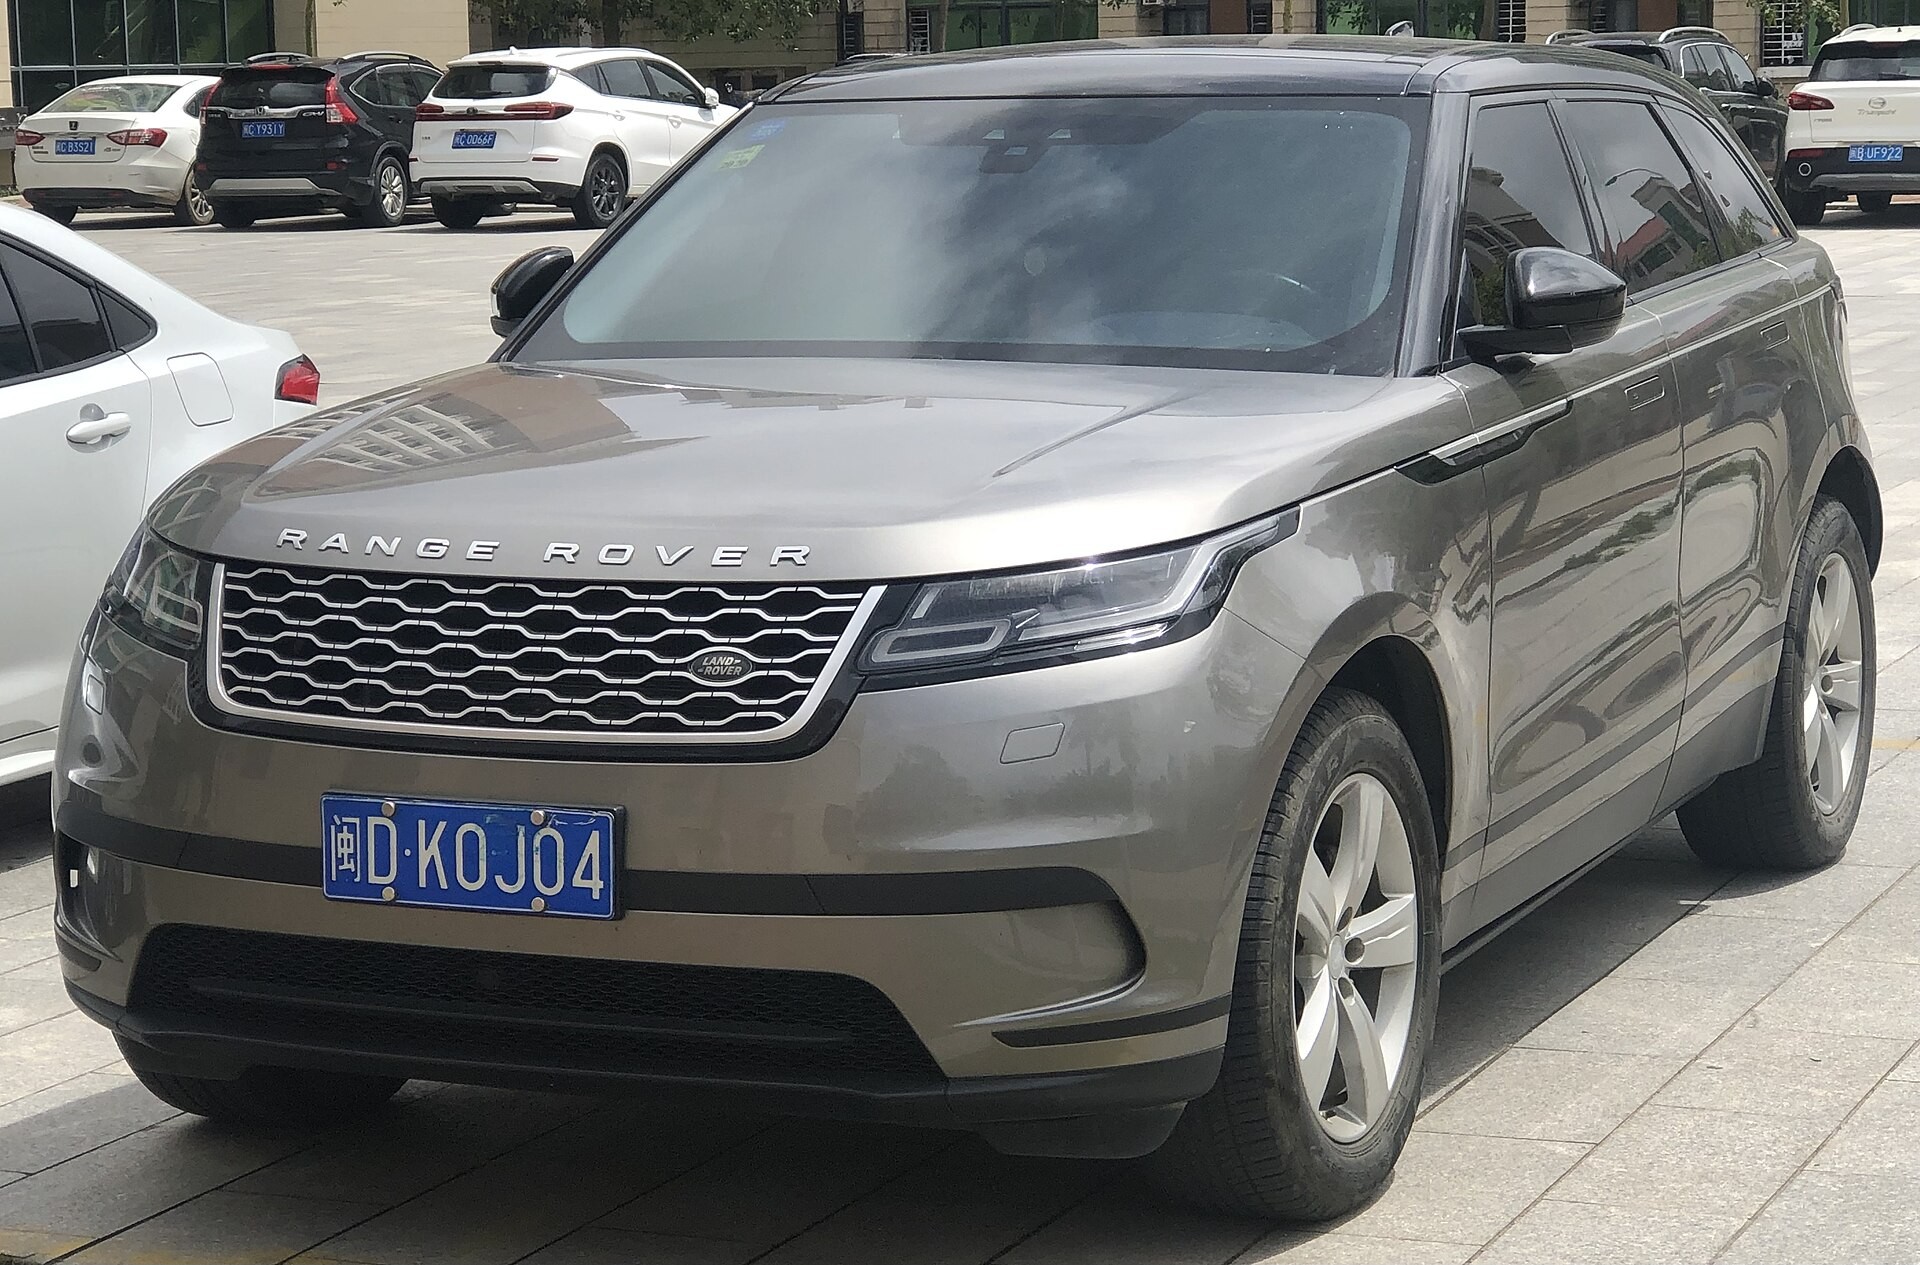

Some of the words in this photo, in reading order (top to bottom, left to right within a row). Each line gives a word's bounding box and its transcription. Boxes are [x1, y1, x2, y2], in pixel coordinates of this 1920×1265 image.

[276, 528, 500, 561] RANGE
[543, 542, 811, 566] ROVER
[702, 656, 735, 666] LAND
[703, 666, 743, 676] ROVER
